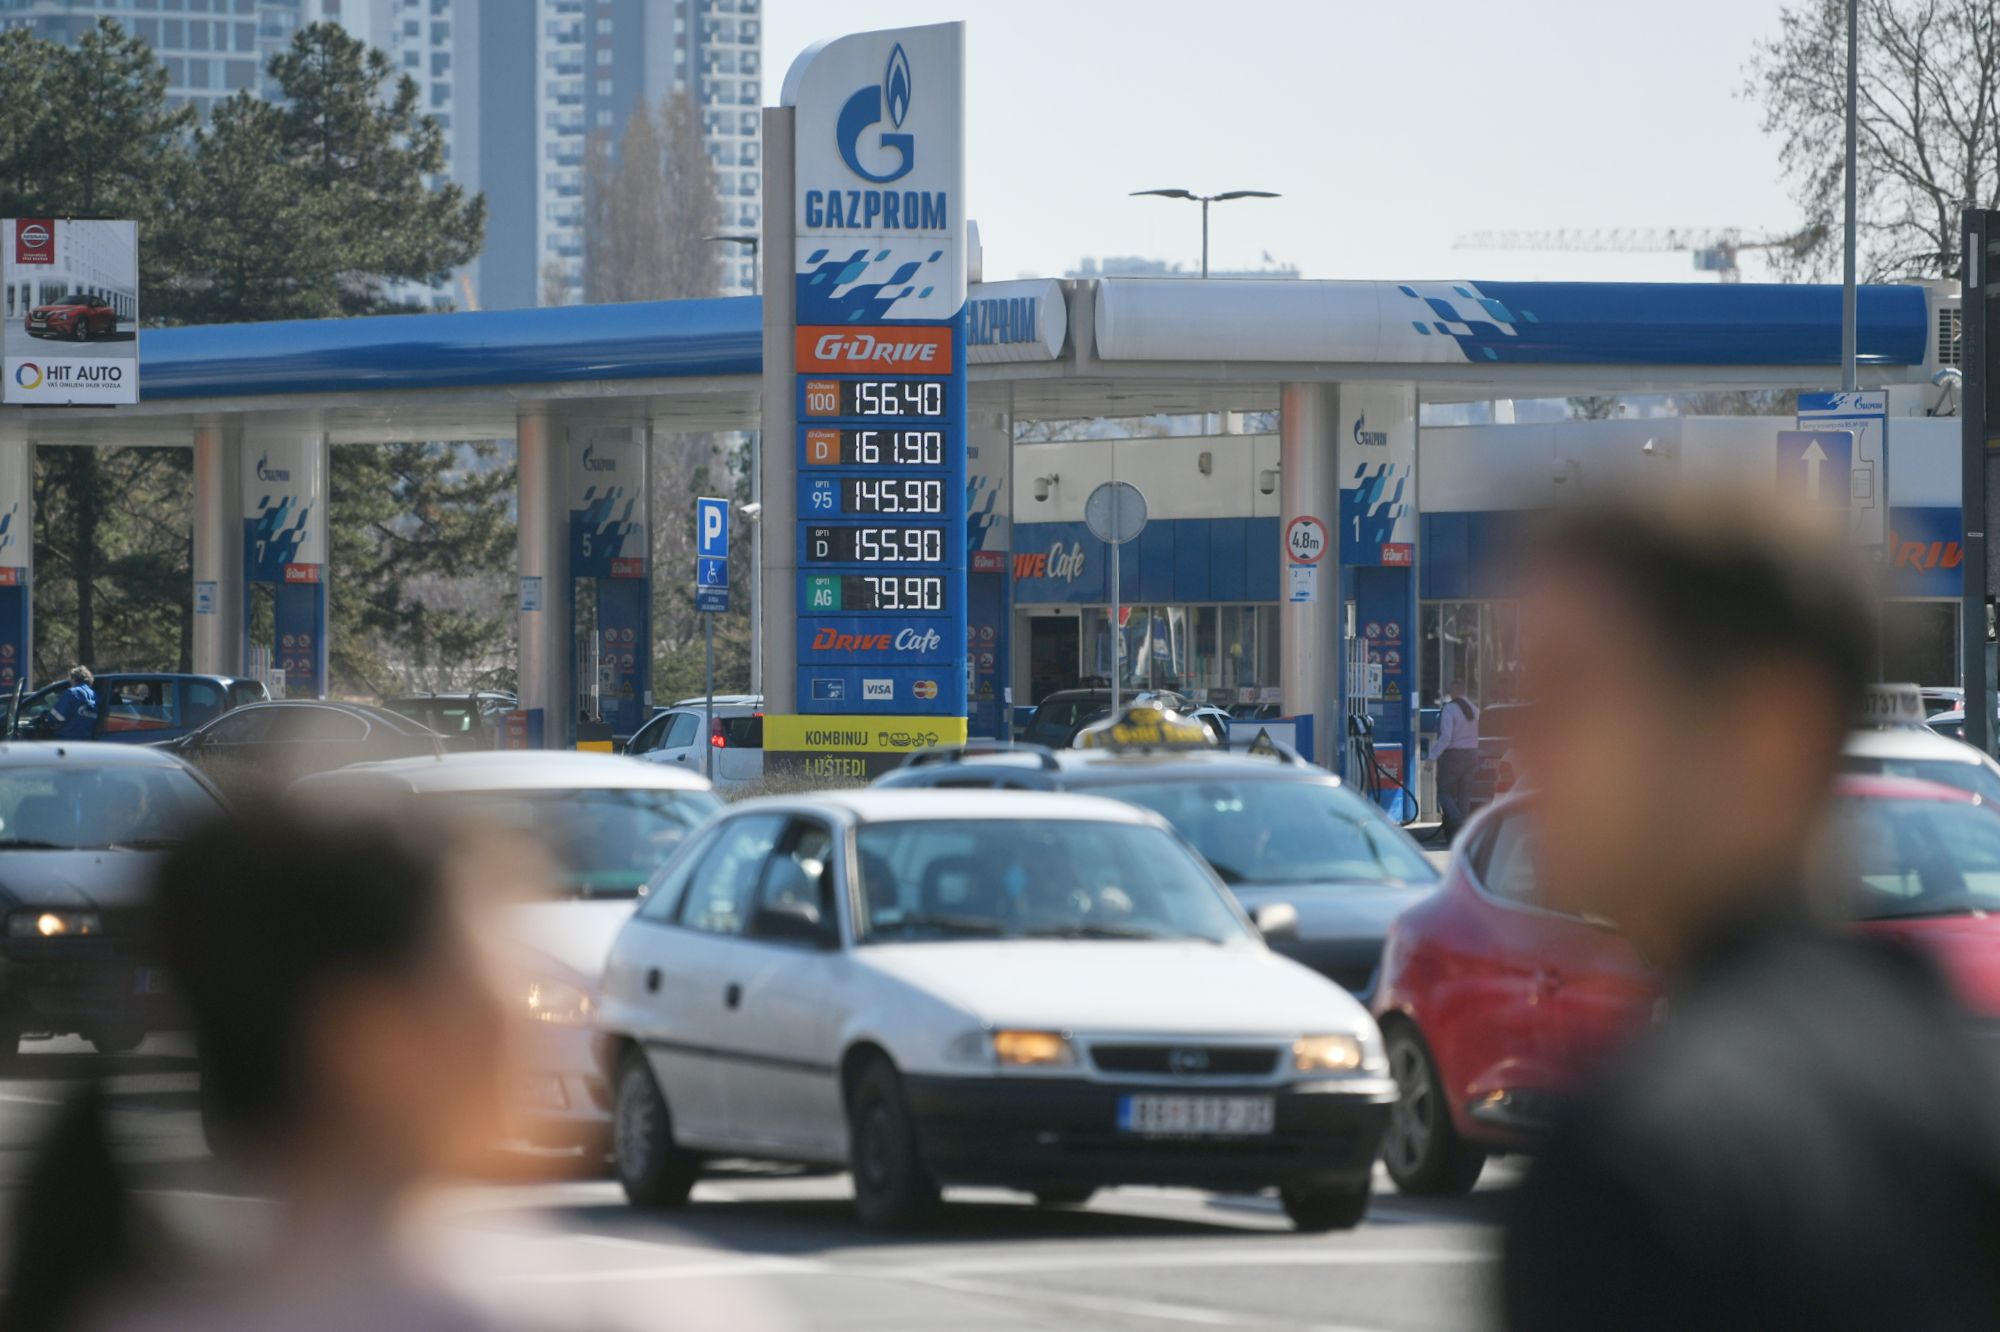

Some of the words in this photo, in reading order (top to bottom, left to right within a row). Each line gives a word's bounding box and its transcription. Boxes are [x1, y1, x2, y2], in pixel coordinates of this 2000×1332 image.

[805, 190, 947, 231] GAZPROM
[47, 366, 72, 380] HIT
[76, 366, 122, 381] AUTO
[807, 393, 835, 411] 100
[855, 382, 941, 415] 156.40
[815, 441, 828, 459] D
[855, 431, 941, 464] 161.90
[812, 491, 832, 509] 95
[855, 480, 941, 513] 145.90
[704, 505, 722, 550] P
[1292, 531, 1319, 550] 4.8m
[1353, 515, 1360, 543] 1
[256, 540, 266, 563] 7
[583, 533, 592, 557] 5
[816, 540, 828, 557] D
[855, 529, 941, 562] 155.90
[1890, 530, 1964, 577] RIV
[1047, 542, 1085, 583] Cafe
[813, 589, 832, 607] AG
[863, 577, 941, 610] 79.90
[812, 627, 894, 652] DRIVE
[894, 627, 941, 654] Cafe
[867, 685, 891, 695] VISA
[805, 731, 868, 746] KOMBINUJ
[814, 754, 866, 777] UŠTEDI
